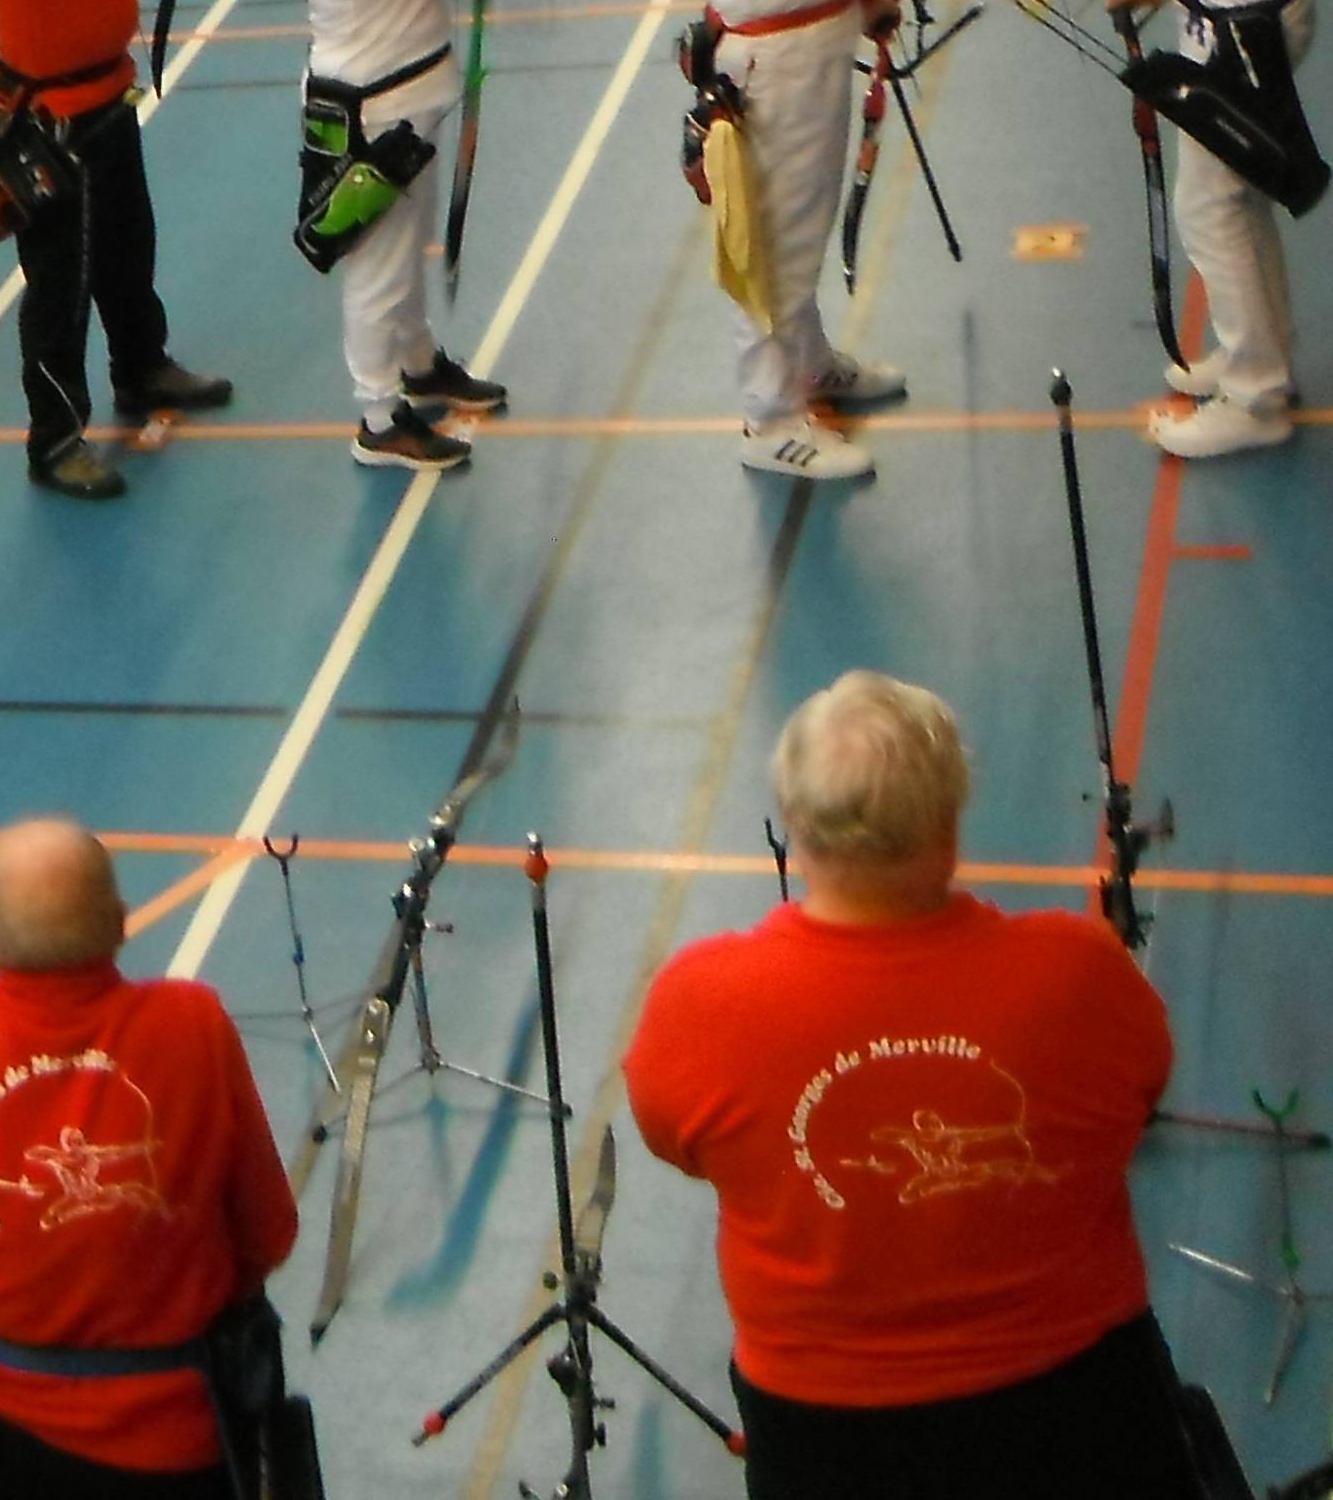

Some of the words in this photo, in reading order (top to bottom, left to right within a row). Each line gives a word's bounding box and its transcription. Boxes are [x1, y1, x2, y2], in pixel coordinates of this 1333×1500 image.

[835, 1050, 861, 1075] de
[868, 1035, 982, 1060] Merville
[4, 1065, 30, 1088] de
